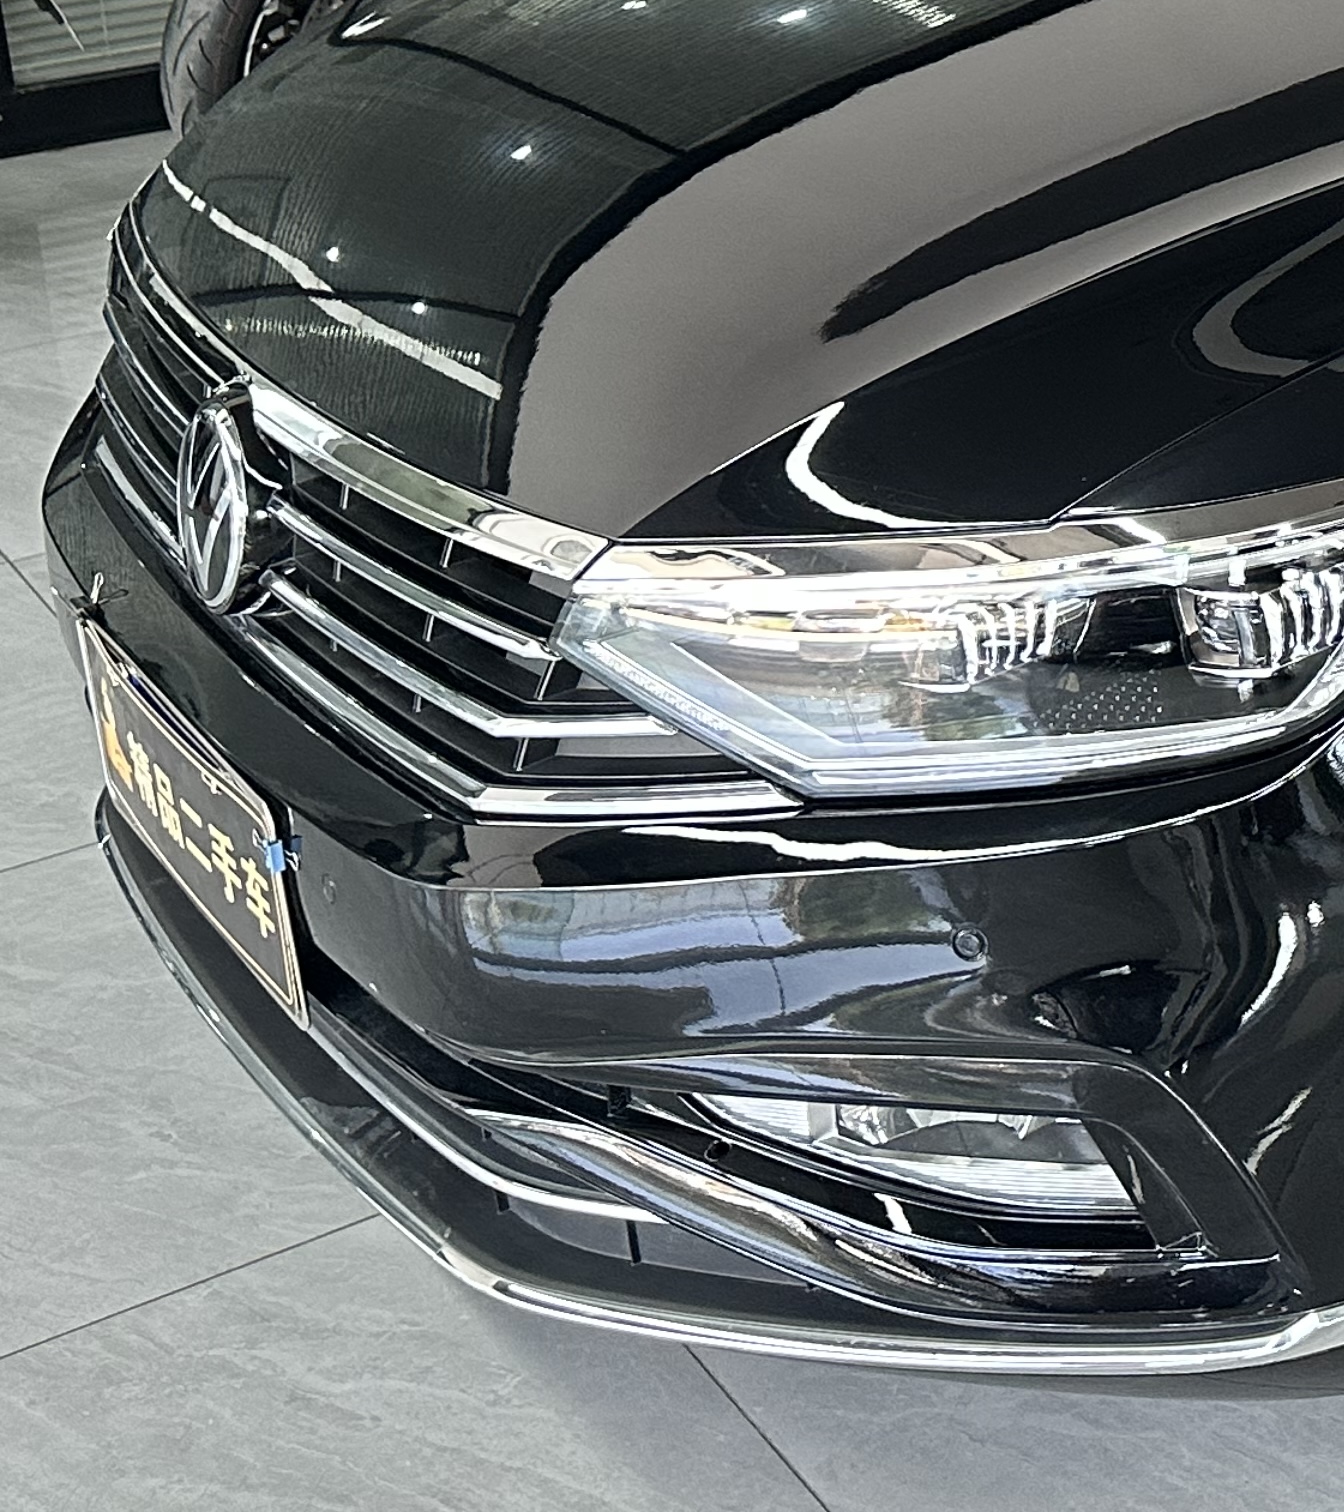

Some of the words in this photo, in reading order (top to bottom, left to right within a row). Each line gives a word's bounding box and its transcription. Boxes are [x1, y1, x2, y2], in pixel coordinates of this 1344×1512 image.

[126, 730, 276, 940] 精品二手车
